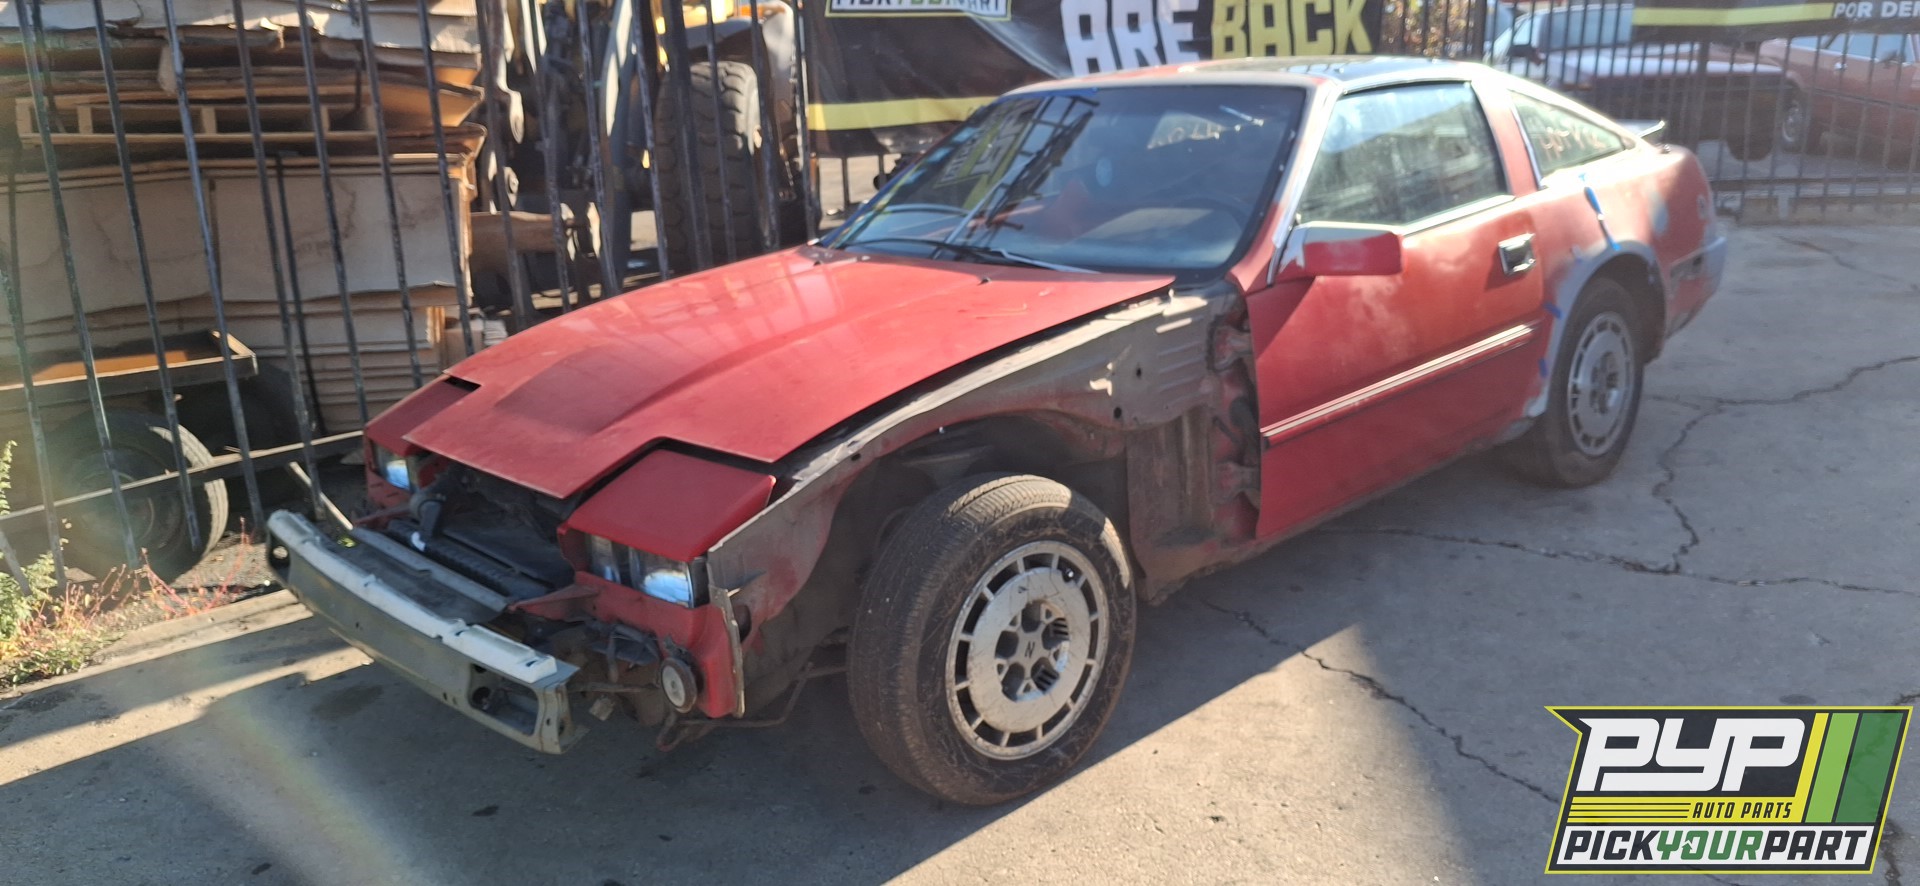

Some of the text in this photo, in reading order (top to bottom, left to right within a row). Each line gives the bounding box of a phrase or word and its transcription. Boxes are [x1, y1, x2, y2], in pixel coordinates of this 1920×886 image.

[1834, 2, 1874, 18] POR
[1061, 0, 1374, 77] ARE BACK
